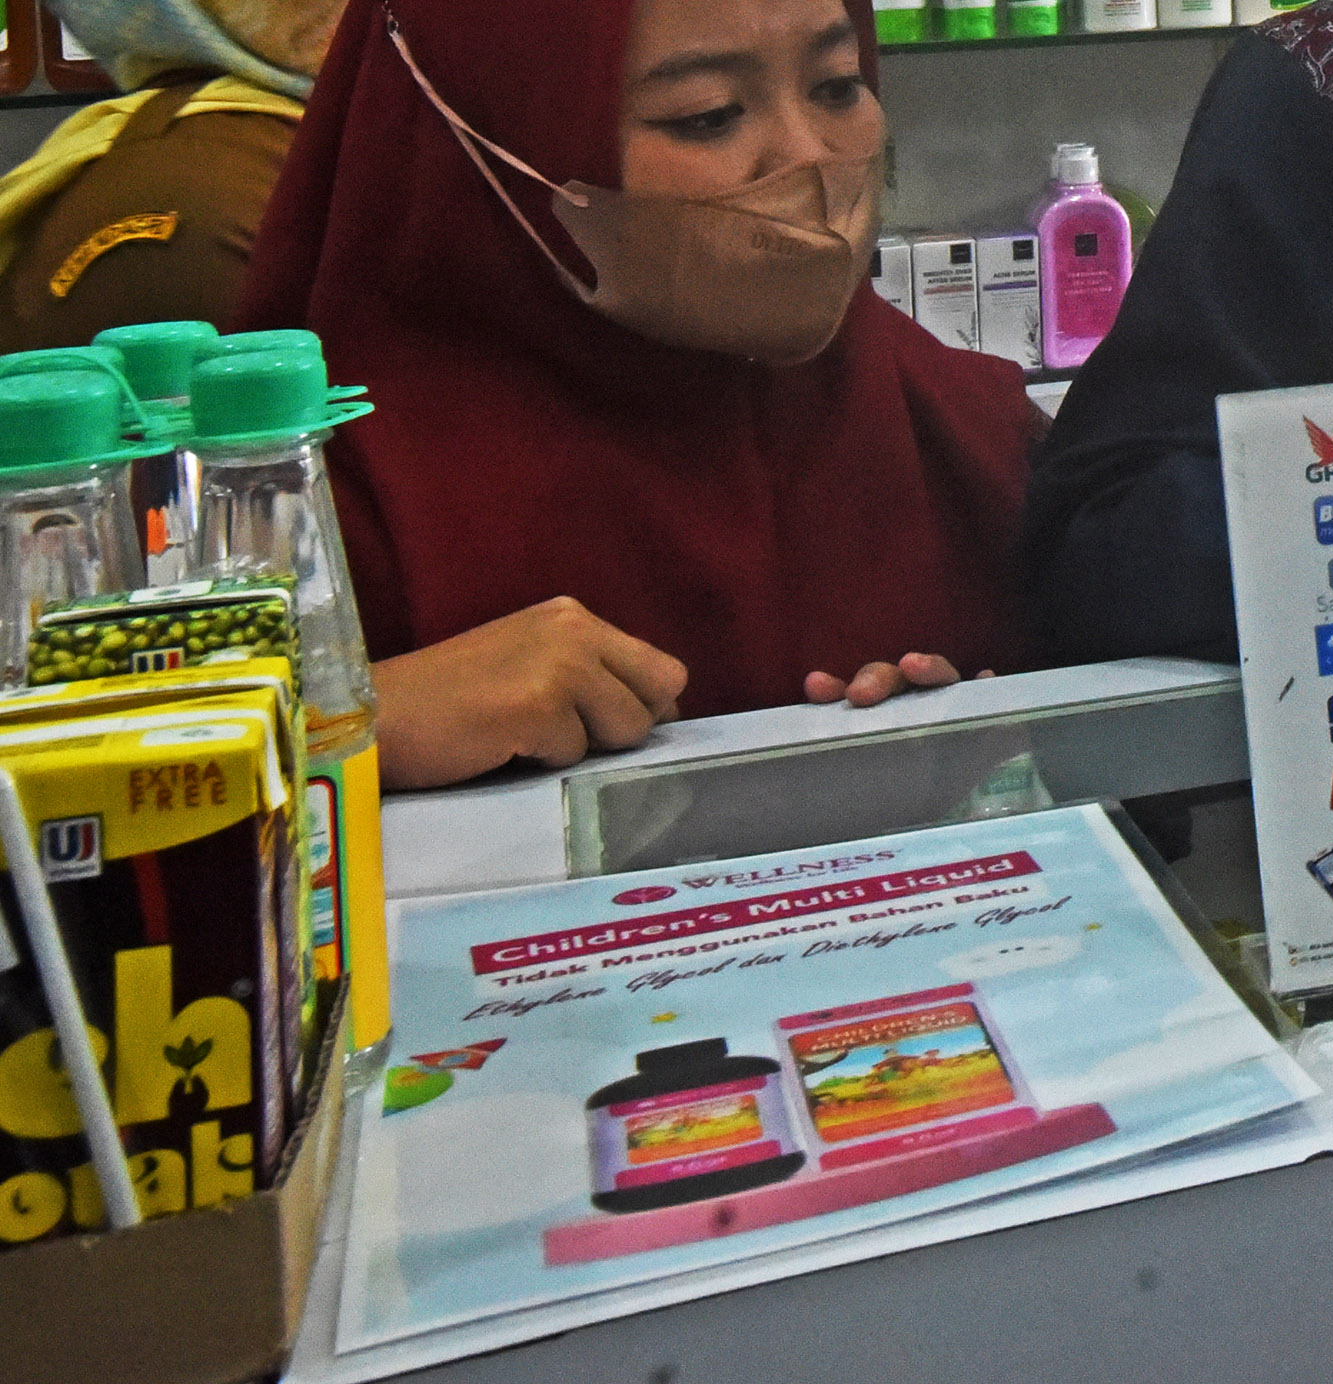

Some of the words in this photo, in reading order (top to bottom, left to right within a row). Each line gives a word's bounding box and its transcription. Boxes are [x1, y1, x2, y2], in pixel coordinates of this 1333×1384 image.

[129, 760, 224, 796] EXTRA
[491, 909, 733, 964] Children's
[748, 882, 866, 917] Multi
[881, 857, 1015, 895] Liquid
[681, 850, 897, 890] WELLNESS
[463, 986, 606, 1022] Ethylene
[626, 958, 731, 993] Glycol
[738, 949, 785, 971] dan
[803, 920, 958, 960] Diethylene
[972, 896, 1071, 927] Glycol
[491, 966, 588, 990] Tidak
[601, 920, 838, 970] Menggunakan
[847, 898, 944, 925] Bahan
[954, 885, 1031, 905] Baku
